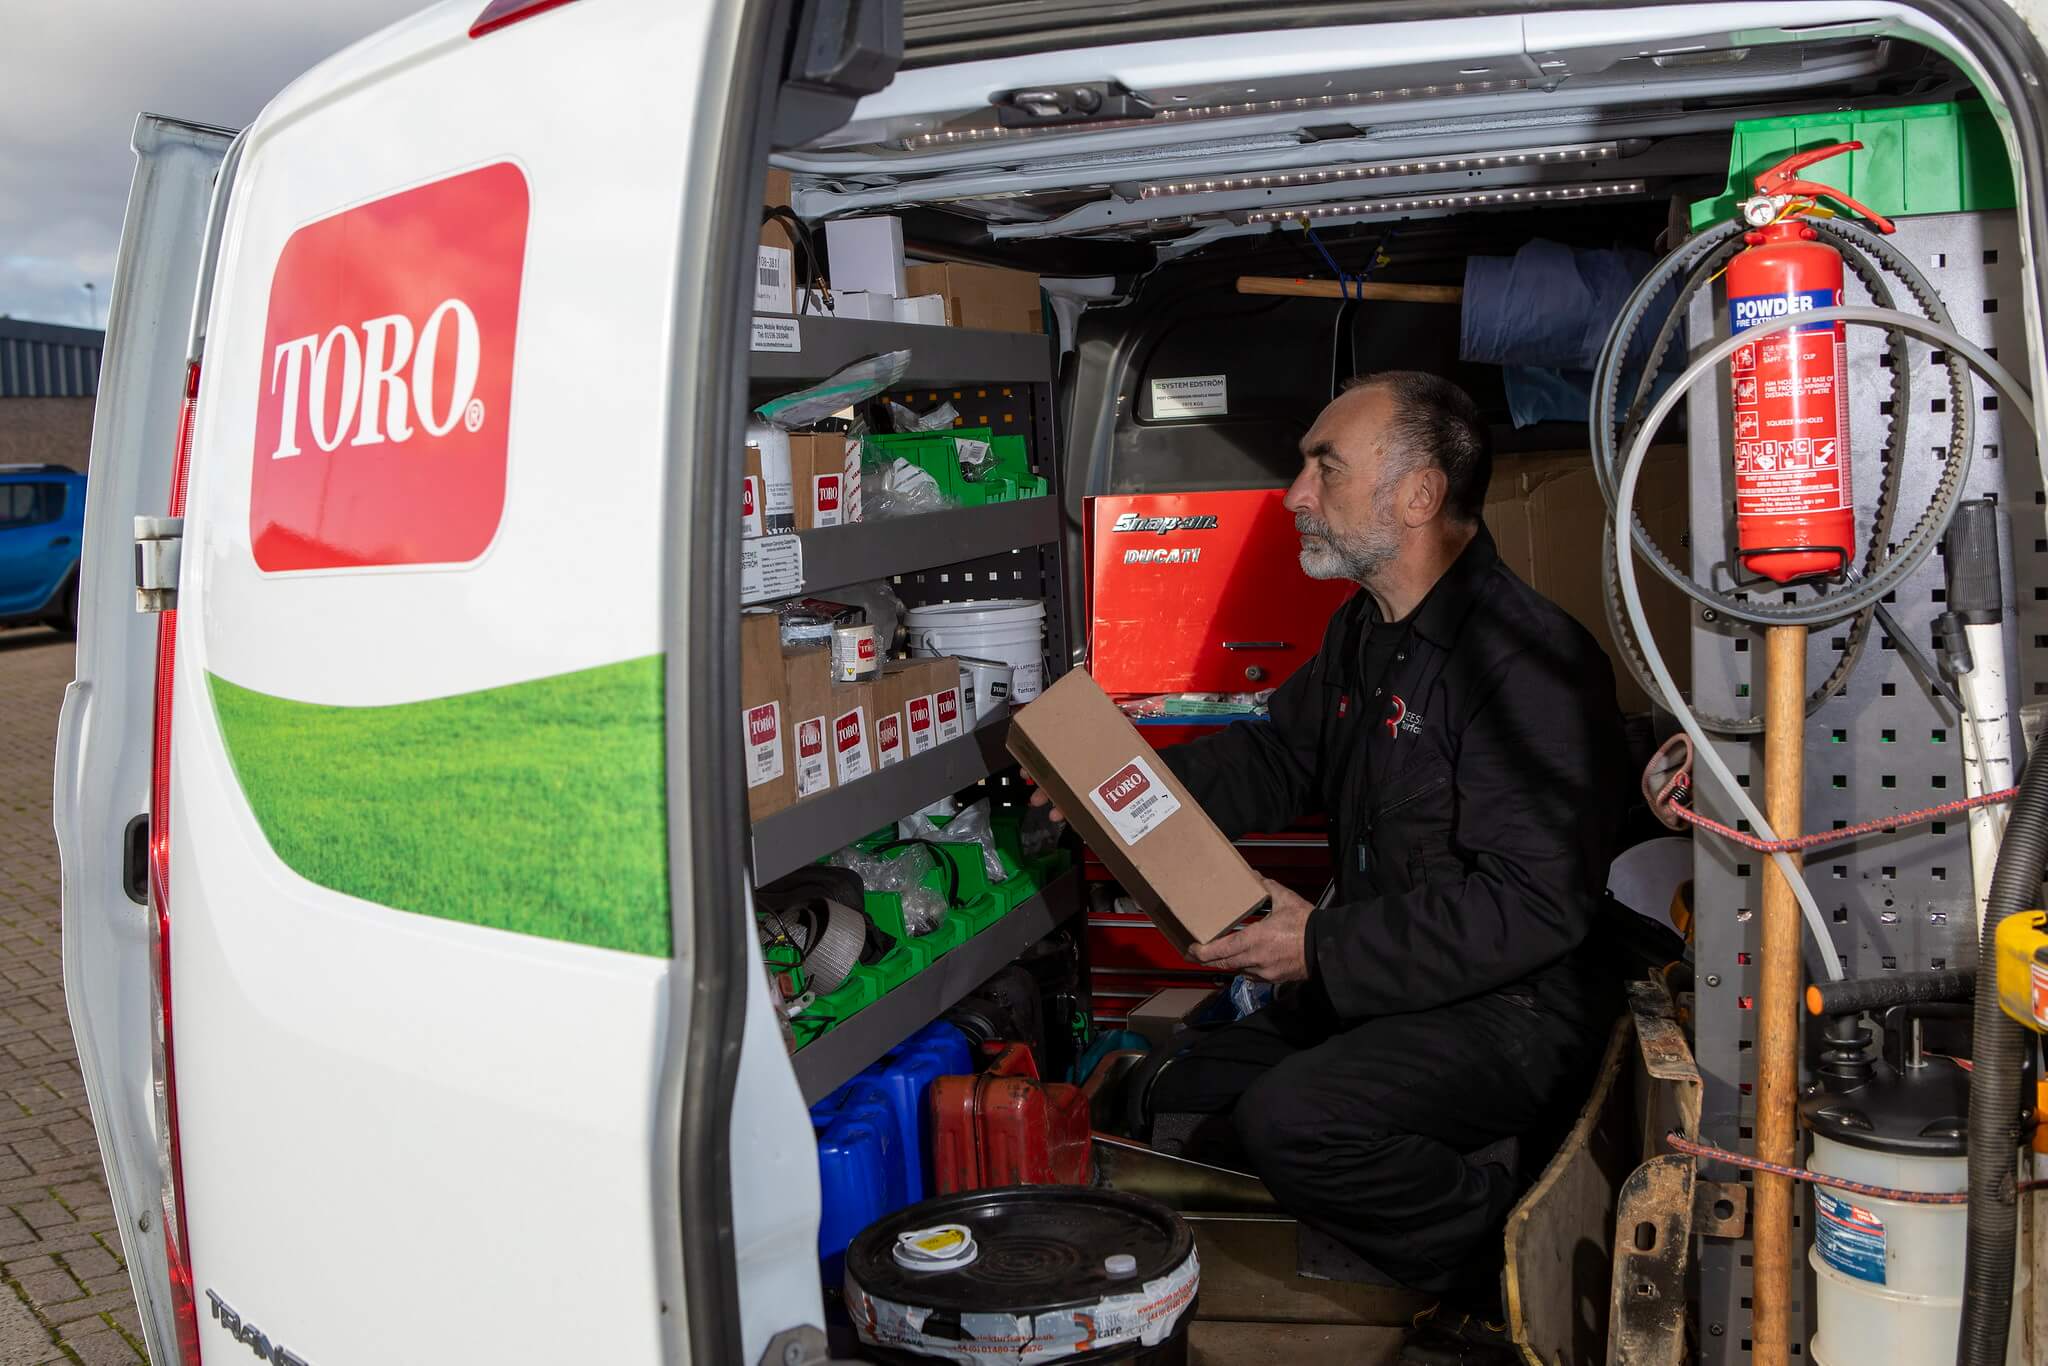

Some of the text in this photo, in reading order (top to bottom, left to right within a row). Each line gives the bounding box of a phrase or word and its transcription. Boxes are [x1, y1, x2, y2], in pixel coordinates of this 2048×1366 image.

[1736, 295, 1814, 319] POWDER
[1736, 319, 1750, 328] FIRE
[1162, 382, 1188, 390] SYSTEM
[1741, 444, 1746, 454] A
[1766, 443, 1774, 454] B
[1797, 441, 1807, 452] C
[820, 486, 838, 502] TORO
[1124, 547, 1201, 565] DUCATI
[939, 700, 955, 714] TORO
[912, 708, 928, 723] TORO
[752, 714, 774, 735] TORO
[838, 723, 858, 742] TORO
[1105, 774, 1142, 802] TORO
